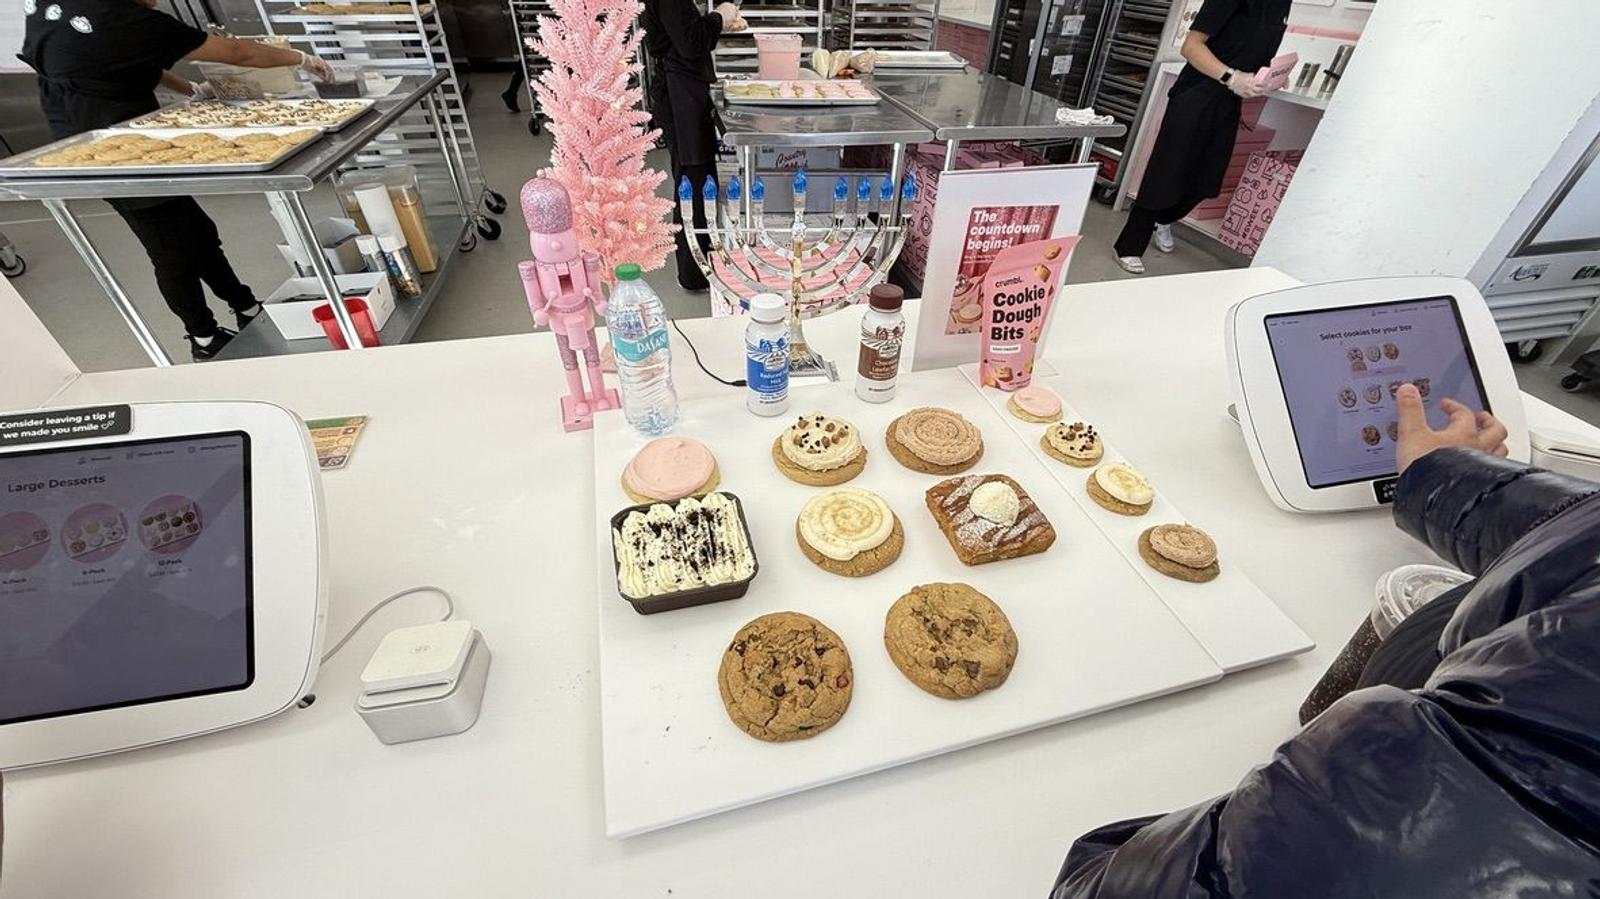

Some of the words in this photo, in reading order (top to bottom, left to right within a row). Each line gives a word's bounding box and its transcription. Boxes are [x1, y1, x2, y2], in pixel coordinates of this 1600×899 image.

[974, 210, 997, 222] The
[1241, 201, 1261, 239] #SWEET
[970, 223, 1040, 235] countdown
[967, 237, 1014, 252] begins!
[993, 285, 1045, 307] Cookie
[992, 303, 1041, 323] Dough
[991, 326, 1024, 341] Bits
[1320, 332, 1342, 340] Select
[1343, 329, 1370, 338] cookies
[1382, 326, 1398, 334] your
[637, 332, 668, 353] DASAN
[0, 418, 44, 429] Consider
[46, 415, 82, 424] leaving
[92, 412, 106, 421] tip
[108, 411, 116, 419] if
[20, 428, 50, 437] made
[51, 427, 70, 436] you
[72, 423, 99, 432] smile
[8, 482, 45, 493] Large
[49, 475, 106, 488] Desserts
